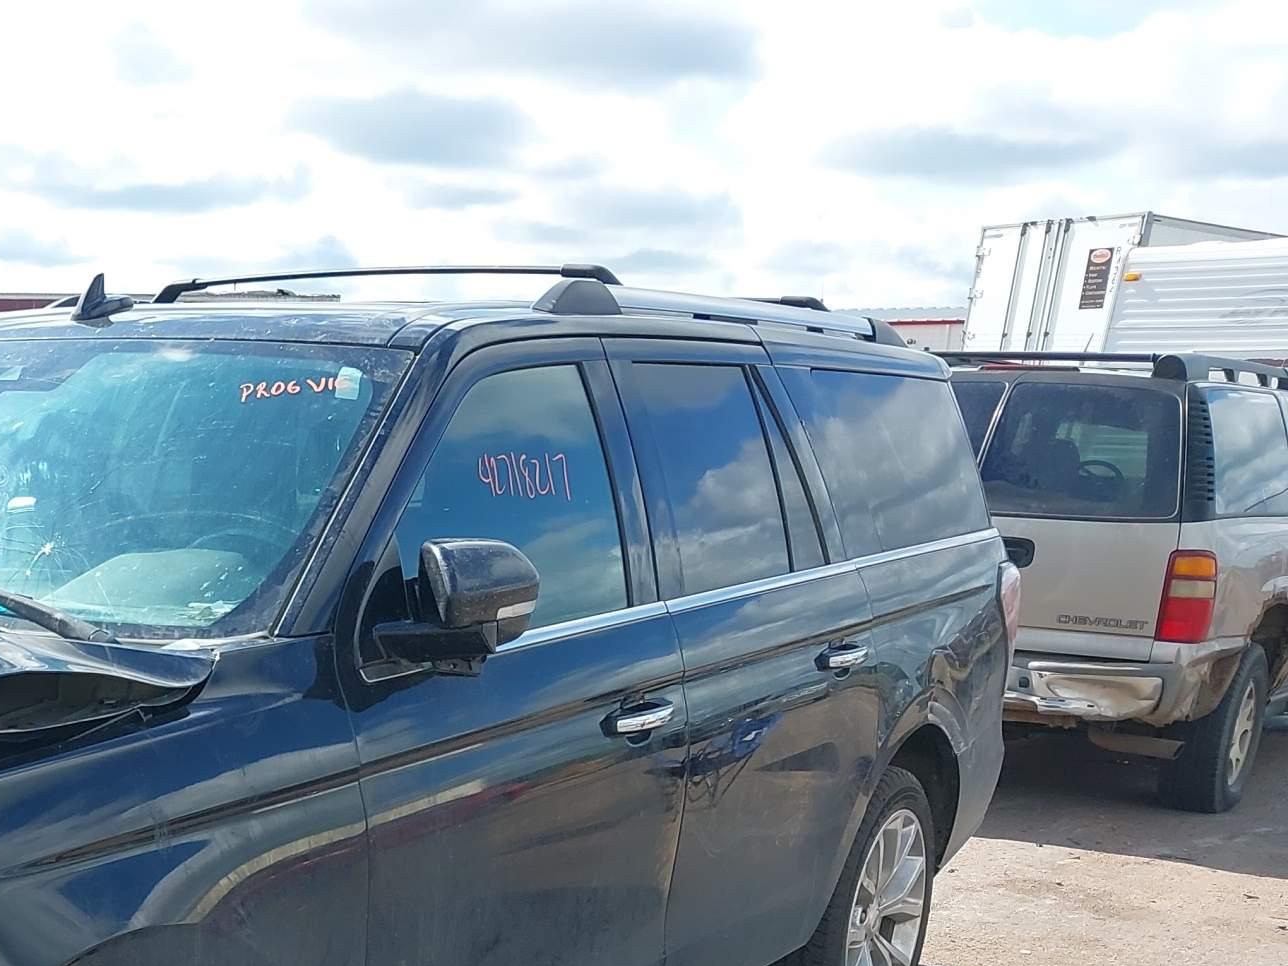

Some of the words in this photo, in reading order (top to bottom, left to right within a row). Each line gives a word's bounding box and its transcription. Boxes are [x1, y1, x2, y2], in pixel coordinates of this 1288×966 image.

[306, 376, 339, 394] VI
[478, 451, 571, 502] 42718217
[1056, 614, 1148, 630] CHEVROLET
